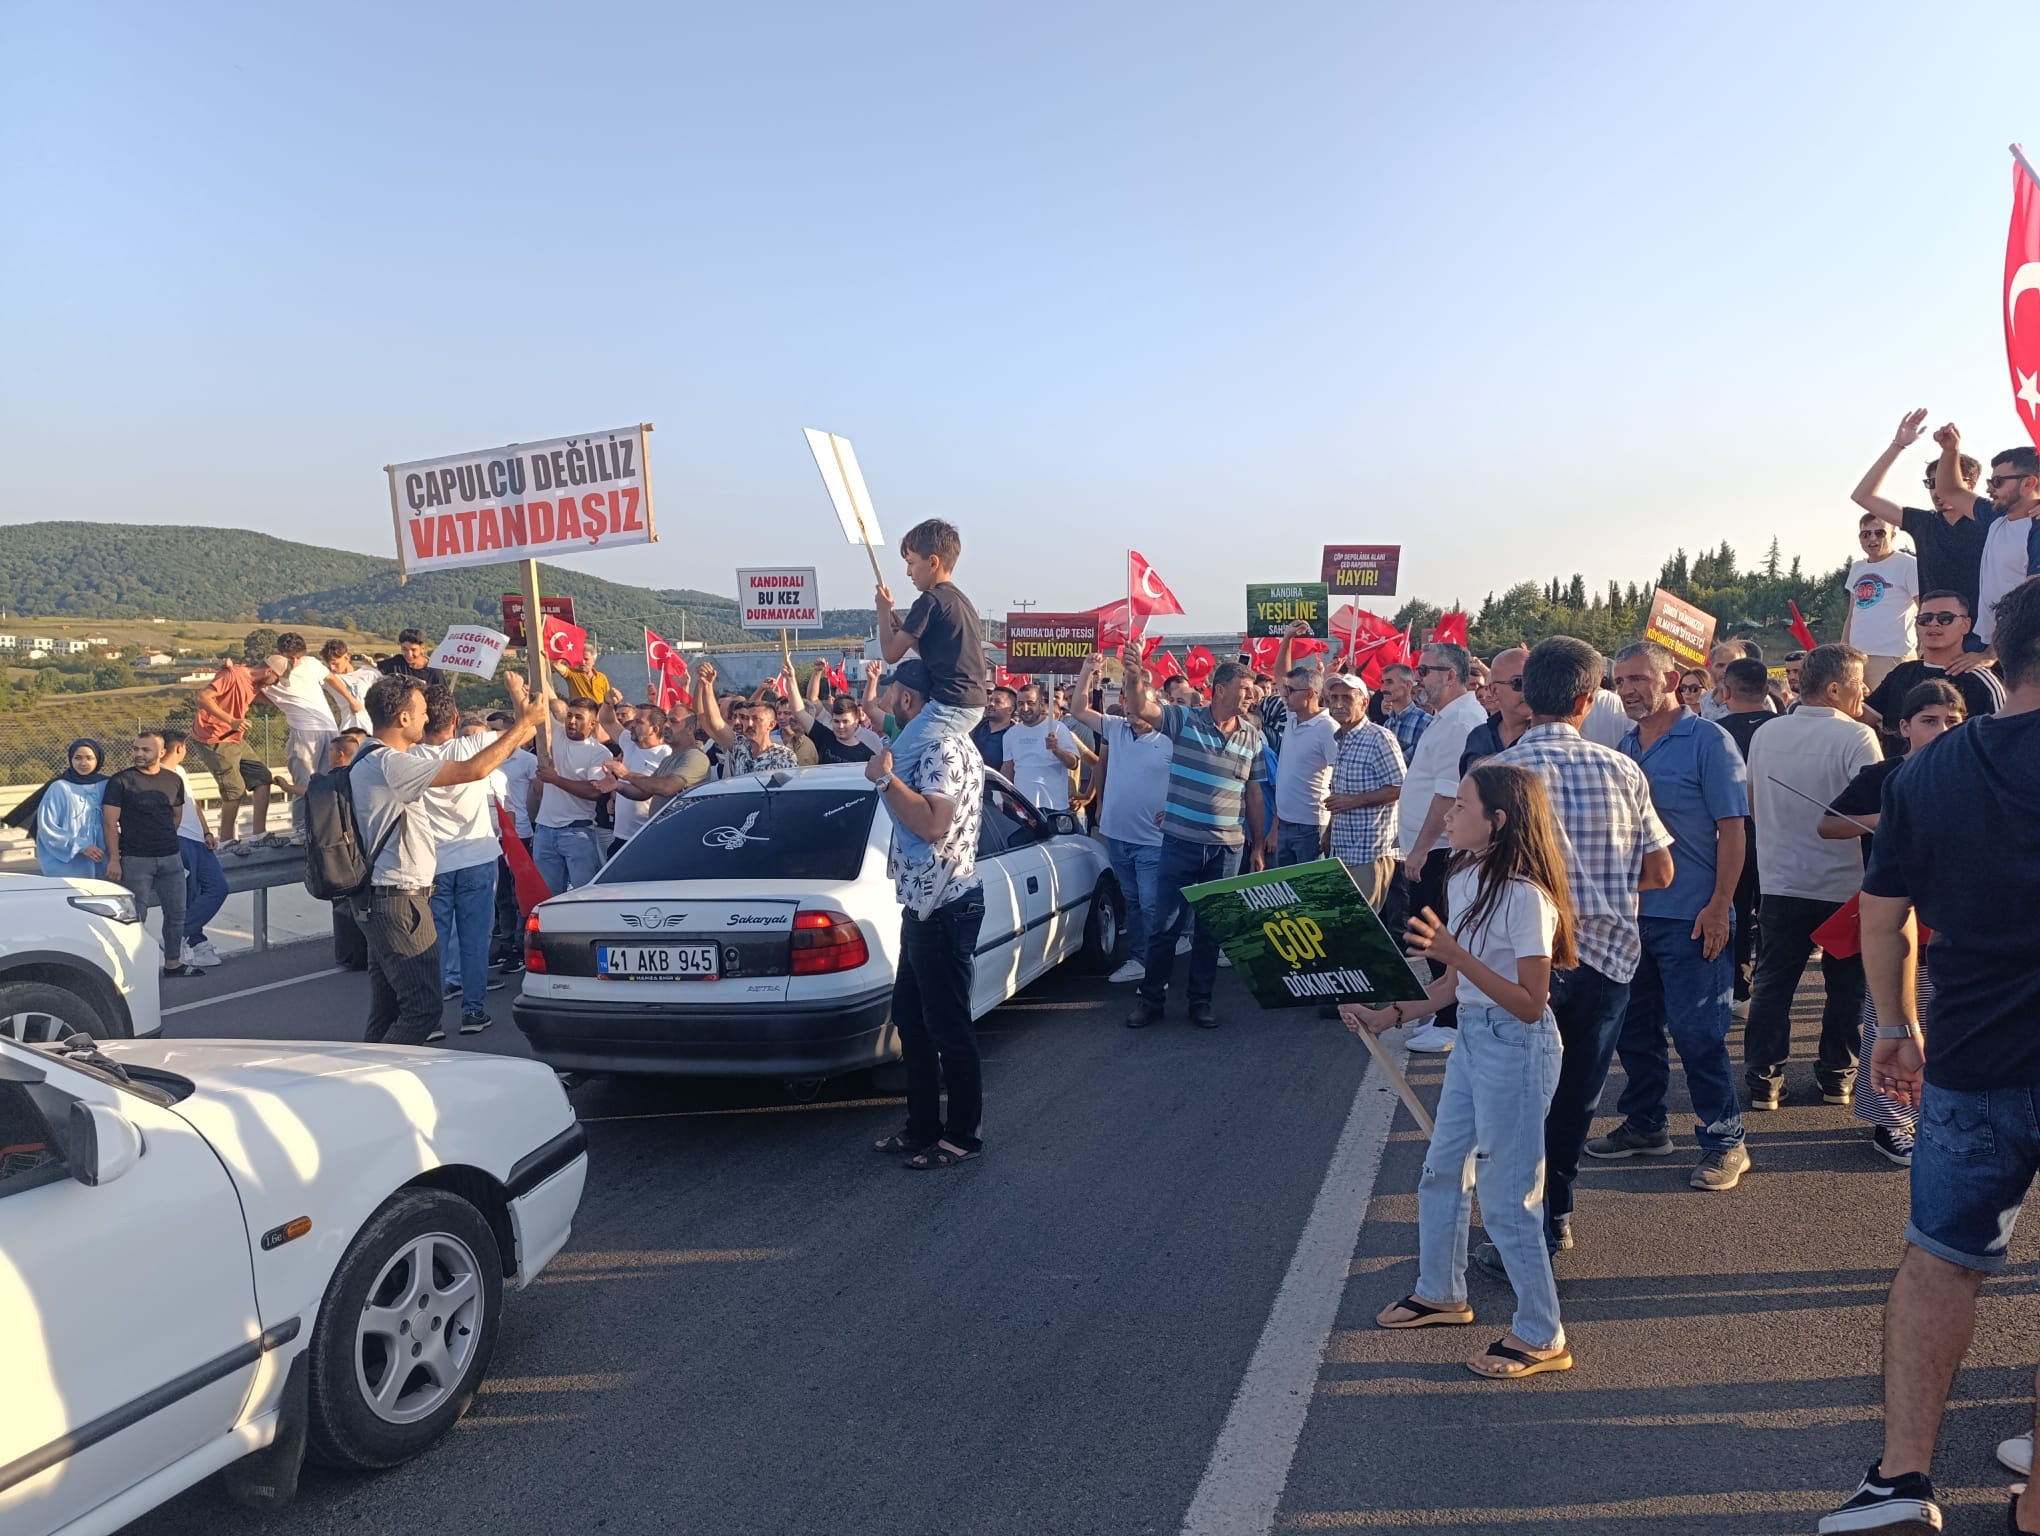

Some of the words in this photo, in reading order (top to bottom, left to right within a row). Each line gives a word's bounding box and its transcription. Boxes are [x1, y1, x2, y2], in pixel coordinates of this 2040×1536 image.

[405, 457, 526, 516] ÇAPULCU
[531, 434, 636, 492] DEĞİLİZ
[409, 487, 643, 559] VATANDAŞIZ
[750, 576, 804, 588] KANDIRALI
[1336, 569, 1379, 586] HAYIR!
[758, 591, 774, 605] BU
[778, 591, 800, 605] KEZ
[1270, 587, 1303, 598] KANDIRA
[746, 608, 815, 620] DURMAYACAK
[1257, 599, 1318, 623] YEŞİLİNE
[1010, 627, 1054, 638] KANDIRA'DA
[1055, 626, 1070, 640] ÇÖP
[1071, 626, 1095, 639] TESİSİ
[1236, 880, 1302, 911] TARIMA
[1263, 911, 1328, 970] ÇÖP
[609, 950, 628, 971] 41
[638, 950, 669, 971] AKB
[678, 950, 712, 971] 945
[1282, 966, 1375, 998] DÖKMEYİN!
